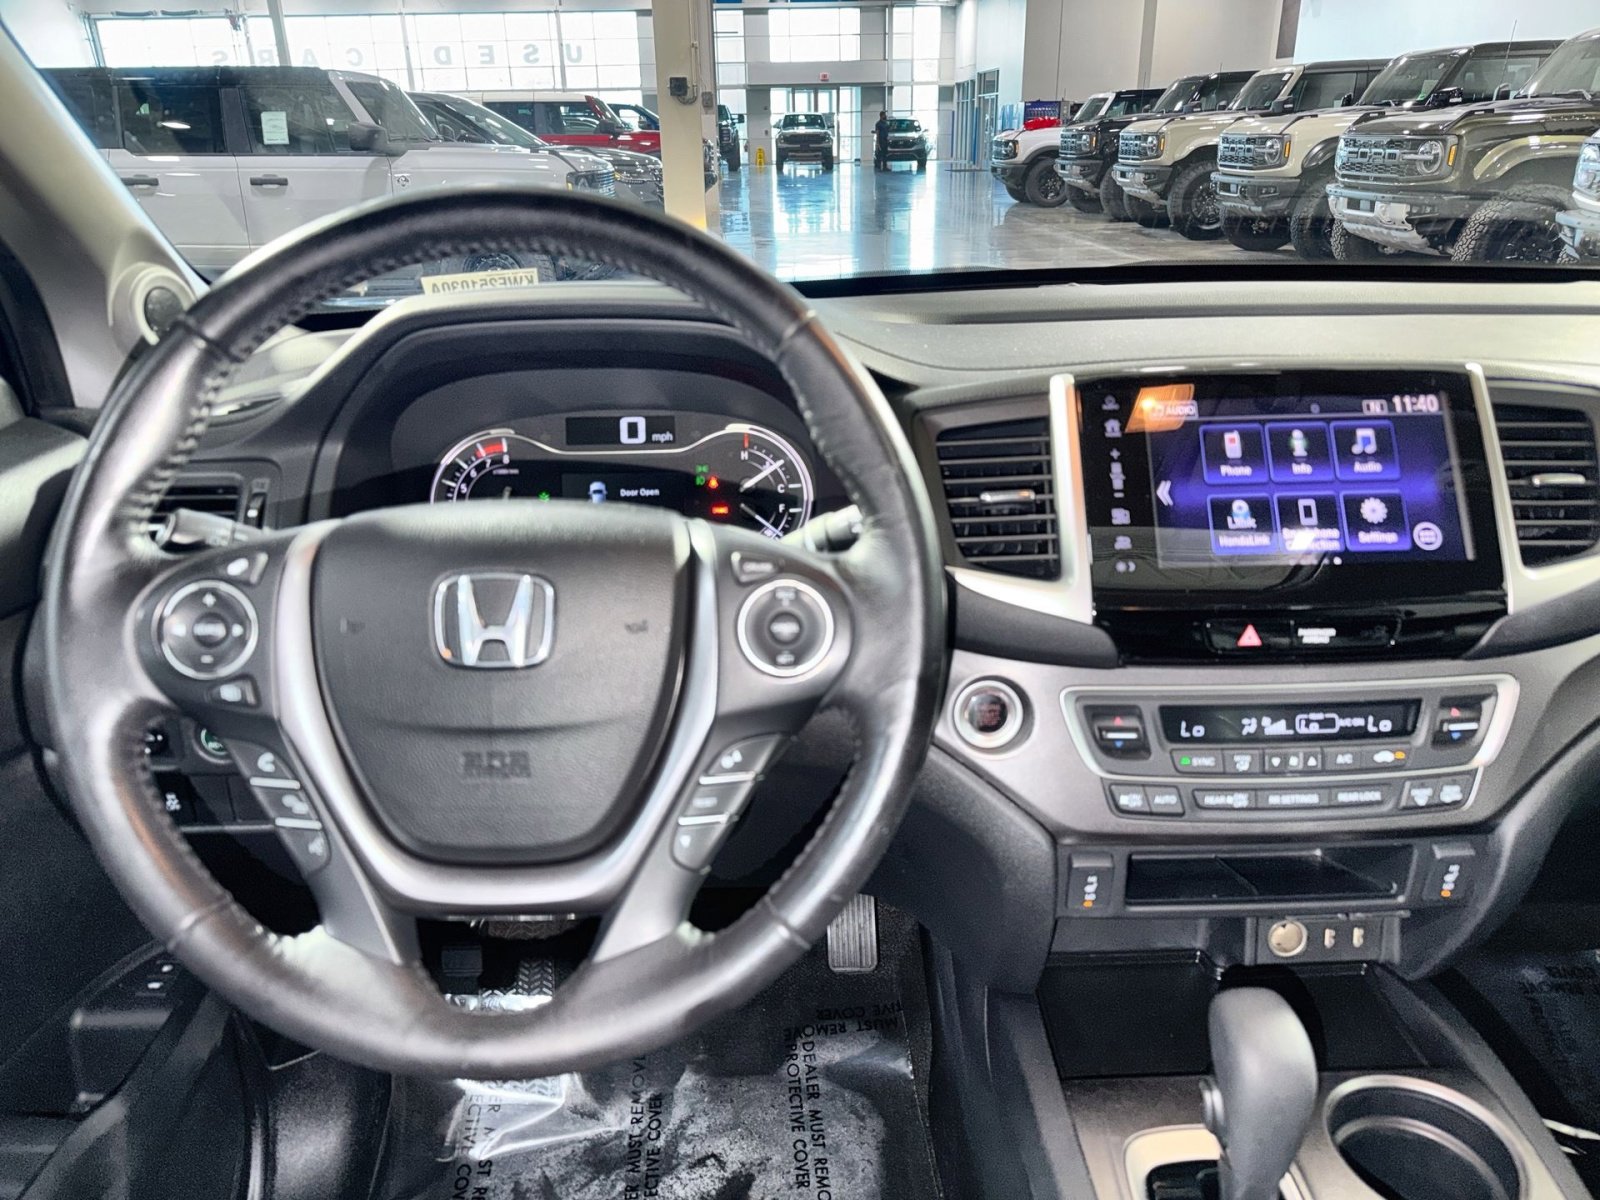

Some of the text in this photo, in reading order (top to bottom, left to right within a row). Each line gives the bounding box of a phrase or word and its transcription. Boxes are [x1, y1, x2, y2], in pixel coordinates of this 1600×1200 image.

[1392, 394, 1440, 413] 11:40
[1165, 404, 1196, 416] AUDIO
[619, 416, 673, 444] 0 mph
[740, 450, 749, 460] H
[469, 468, 477, 478] 6
[1220, 465, 1252, 477] Phone
[1354, 461, 1383, 473] Audio
[460, 483, 467, 493] 5
[620, 488, 660, 497] Door Open
[777, 484, 785, 493] C
[779, 504, 786, 513] F
[1358, 530, 1399, 544] Settings
[815, 1006, 867, 1022] COVER
[802, 1040, 821, 1101] DEALER
[785, 1043, 811, 1189] PROTECTIVE COVER
[808, 1109, 826, 1149] MUST
[625, 1134, 643, 1173] MUST
